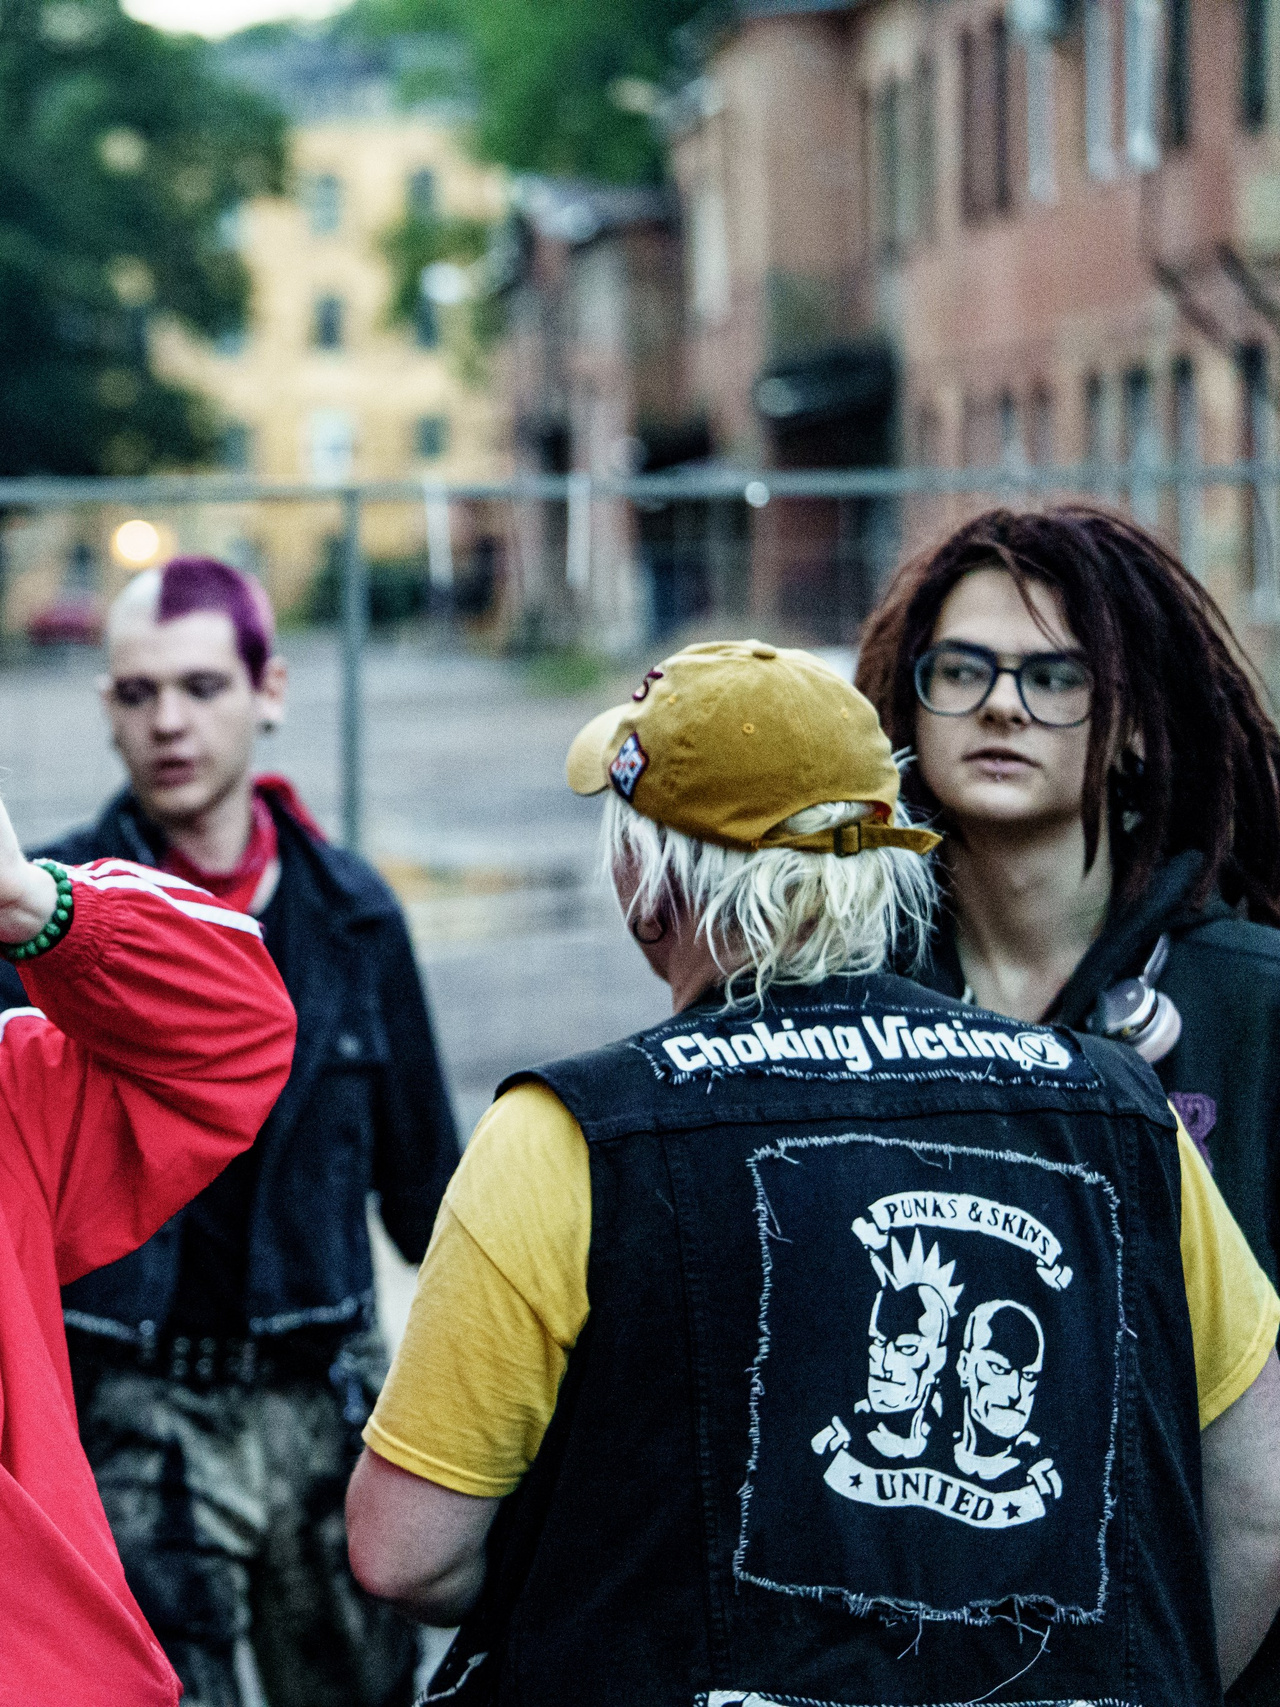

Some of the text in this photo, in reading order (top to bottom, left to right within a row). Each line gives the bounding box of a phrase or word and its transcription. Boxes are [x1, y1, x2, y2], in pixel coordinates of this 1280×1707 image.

[662, 1018, 873, 1073] Choking
[884, 1197, 1051, 1256] PUNKS & SKINS
[875, 1472, 995, 1521] UNITED
